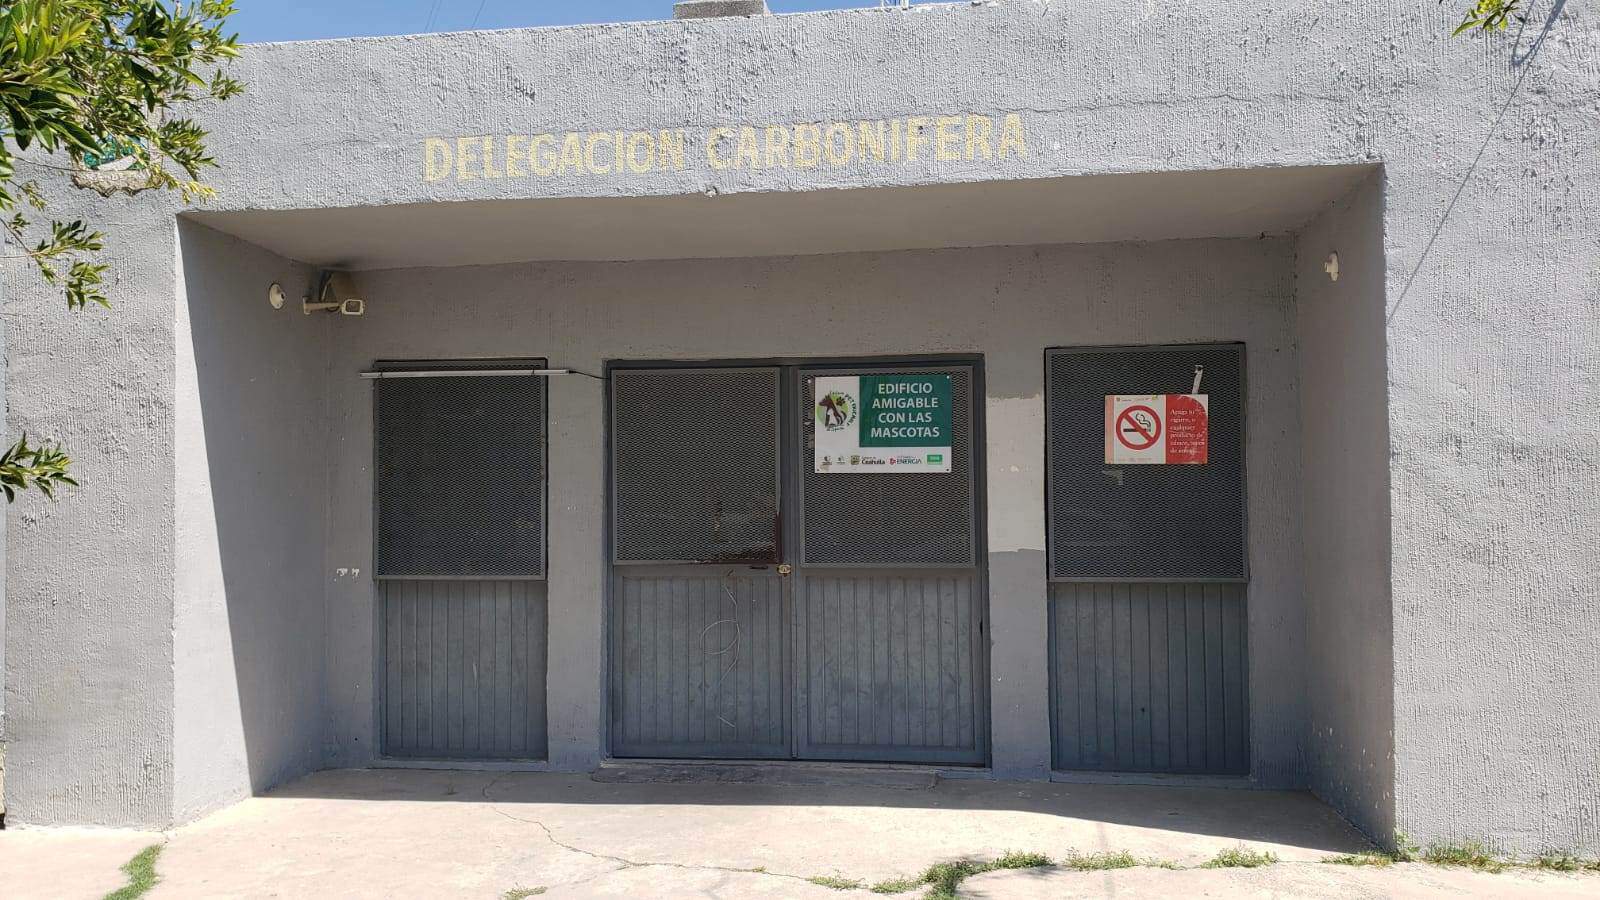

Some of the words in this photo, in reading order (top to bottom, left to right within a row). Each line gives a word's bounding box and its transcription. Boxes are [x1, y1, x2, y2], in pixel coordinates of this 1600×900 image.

[423, 128, 685, 182] DELEGACION
[706, 113, 1026, 170] CARBONIFERA
[878, 382, 933, 394] EDIFICIO
[872, 397, 939, 409] AMIGABLE
[878, 412, 906, 424] CON
[908, 412, 933, 423] LAS
[870, 426, 940, 438] MASCOTAS
